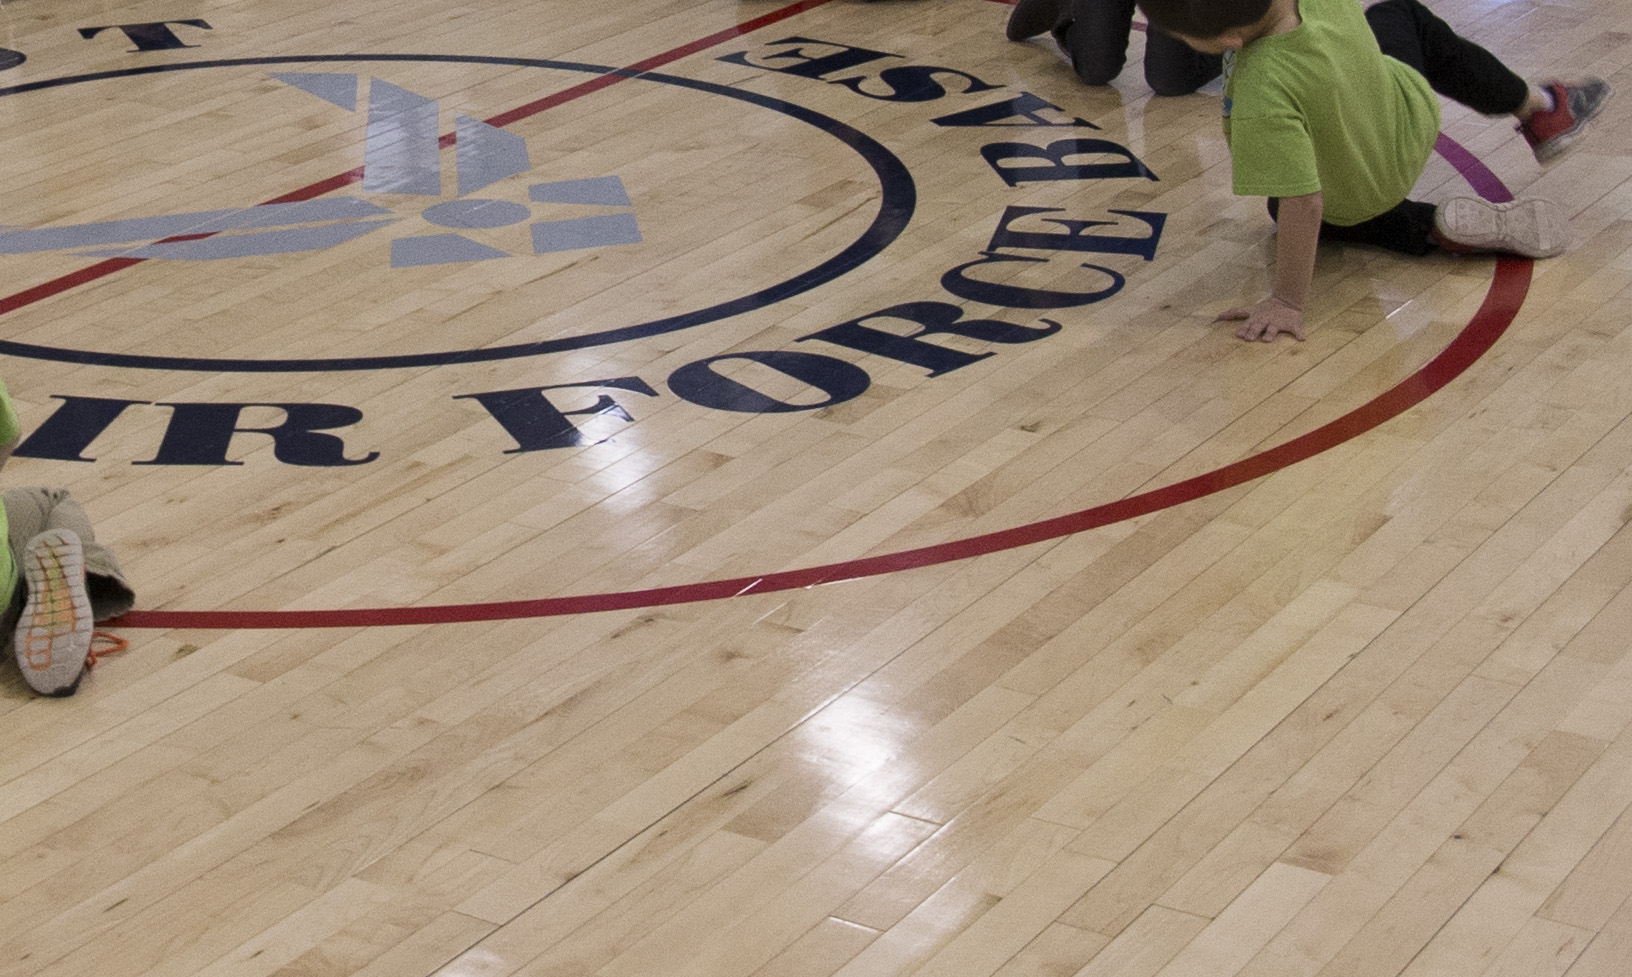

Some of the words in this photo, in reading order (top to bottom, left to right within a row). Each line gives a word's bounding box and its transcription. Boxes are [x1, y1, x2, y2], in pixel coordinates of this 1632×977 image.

[716, 36, 1161, 187] BASE
[452, 205, 1168, 455] FORCE
[11, 394, 381, 467] IR
